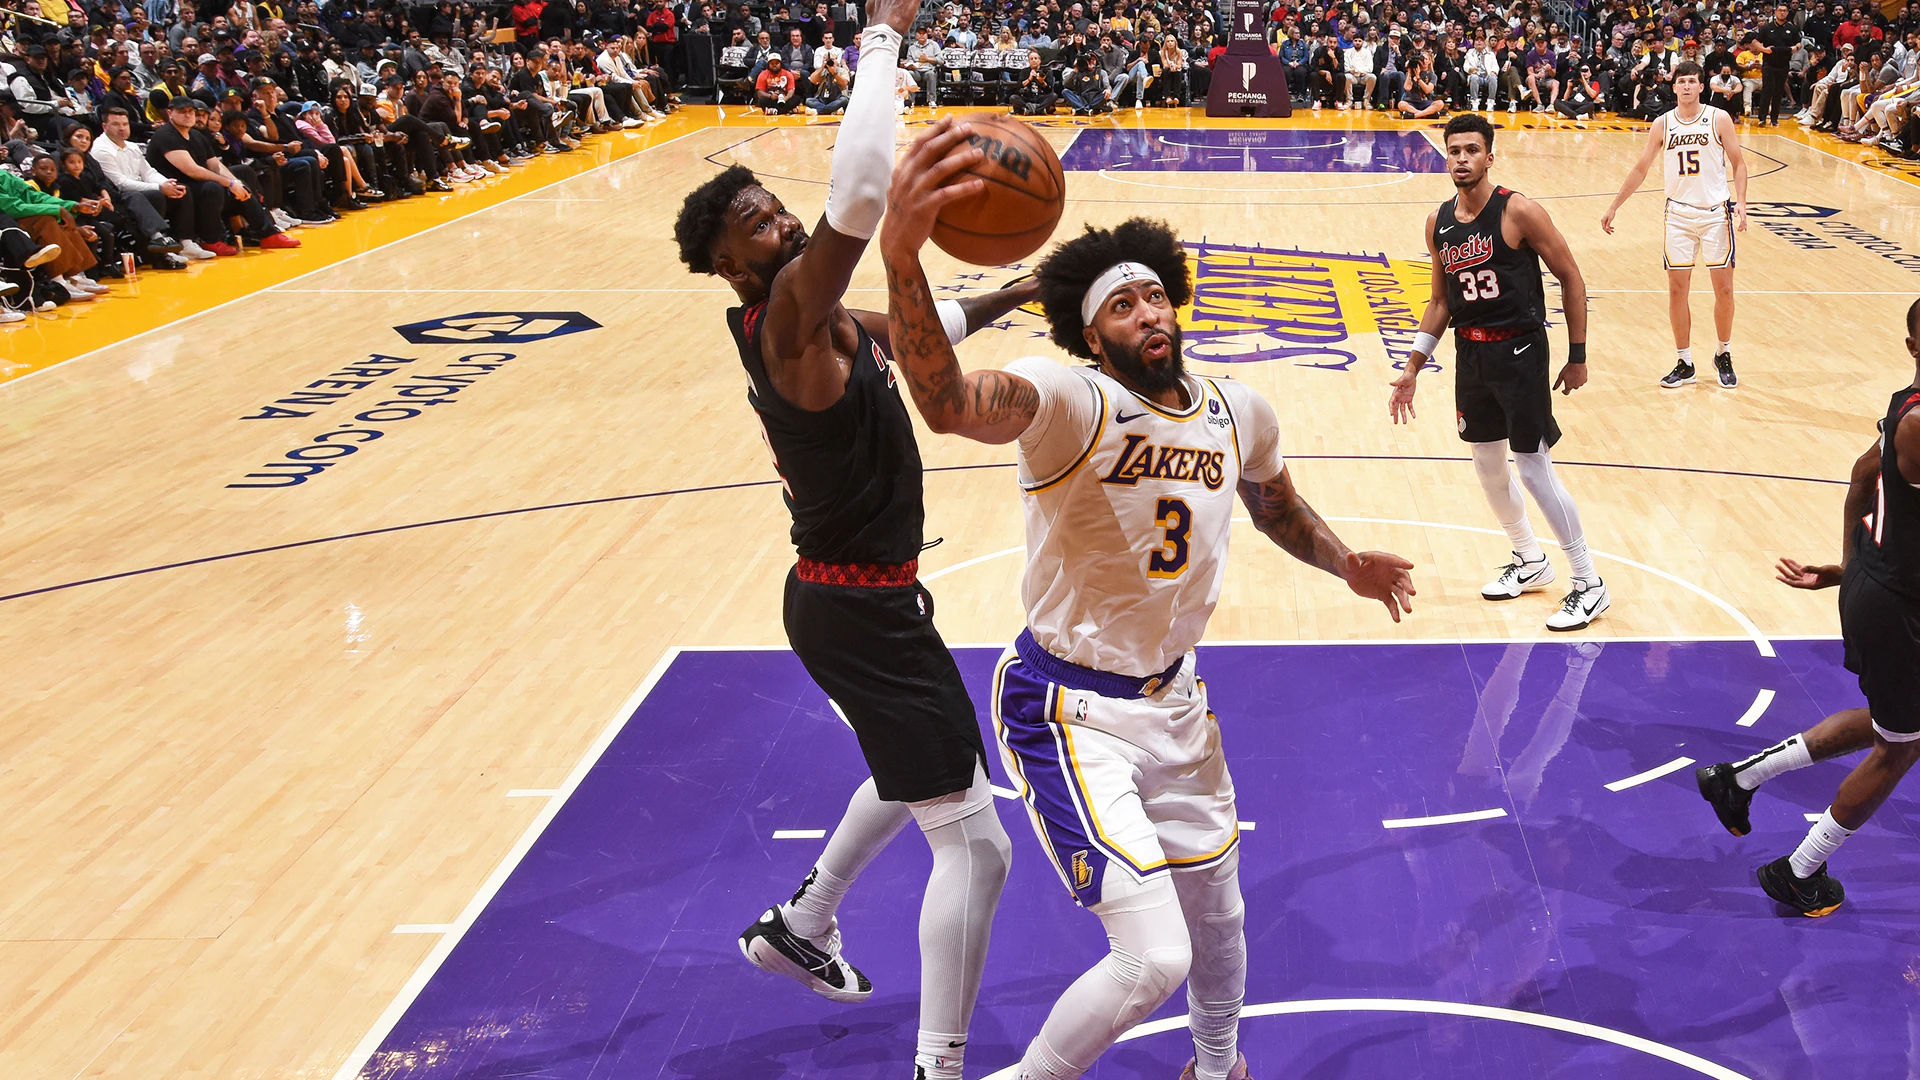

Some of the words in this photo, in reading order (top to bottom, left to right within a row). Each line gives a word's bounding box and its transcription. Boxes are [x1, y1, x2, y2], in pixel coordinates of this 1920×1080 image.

[1667, 133, 1709, 150] LAKERS
[1677, 150, 1700, 177] 15
[1753, 220, 1838, 250] ARENA
[1815, 221, 1920, 276] crypto.co
[1357, 270, 1405, 295] LOS
[1458, 269, 1500, 302] 33
[238, 353, 419, 420] ARENA
[224, 352, 517, 489] crypto.com
[1206, 414, 1230, 429] bibigo
[1099, 433, 1225, 492] LAKERS
[1147, 496, 1194, 579] 3
